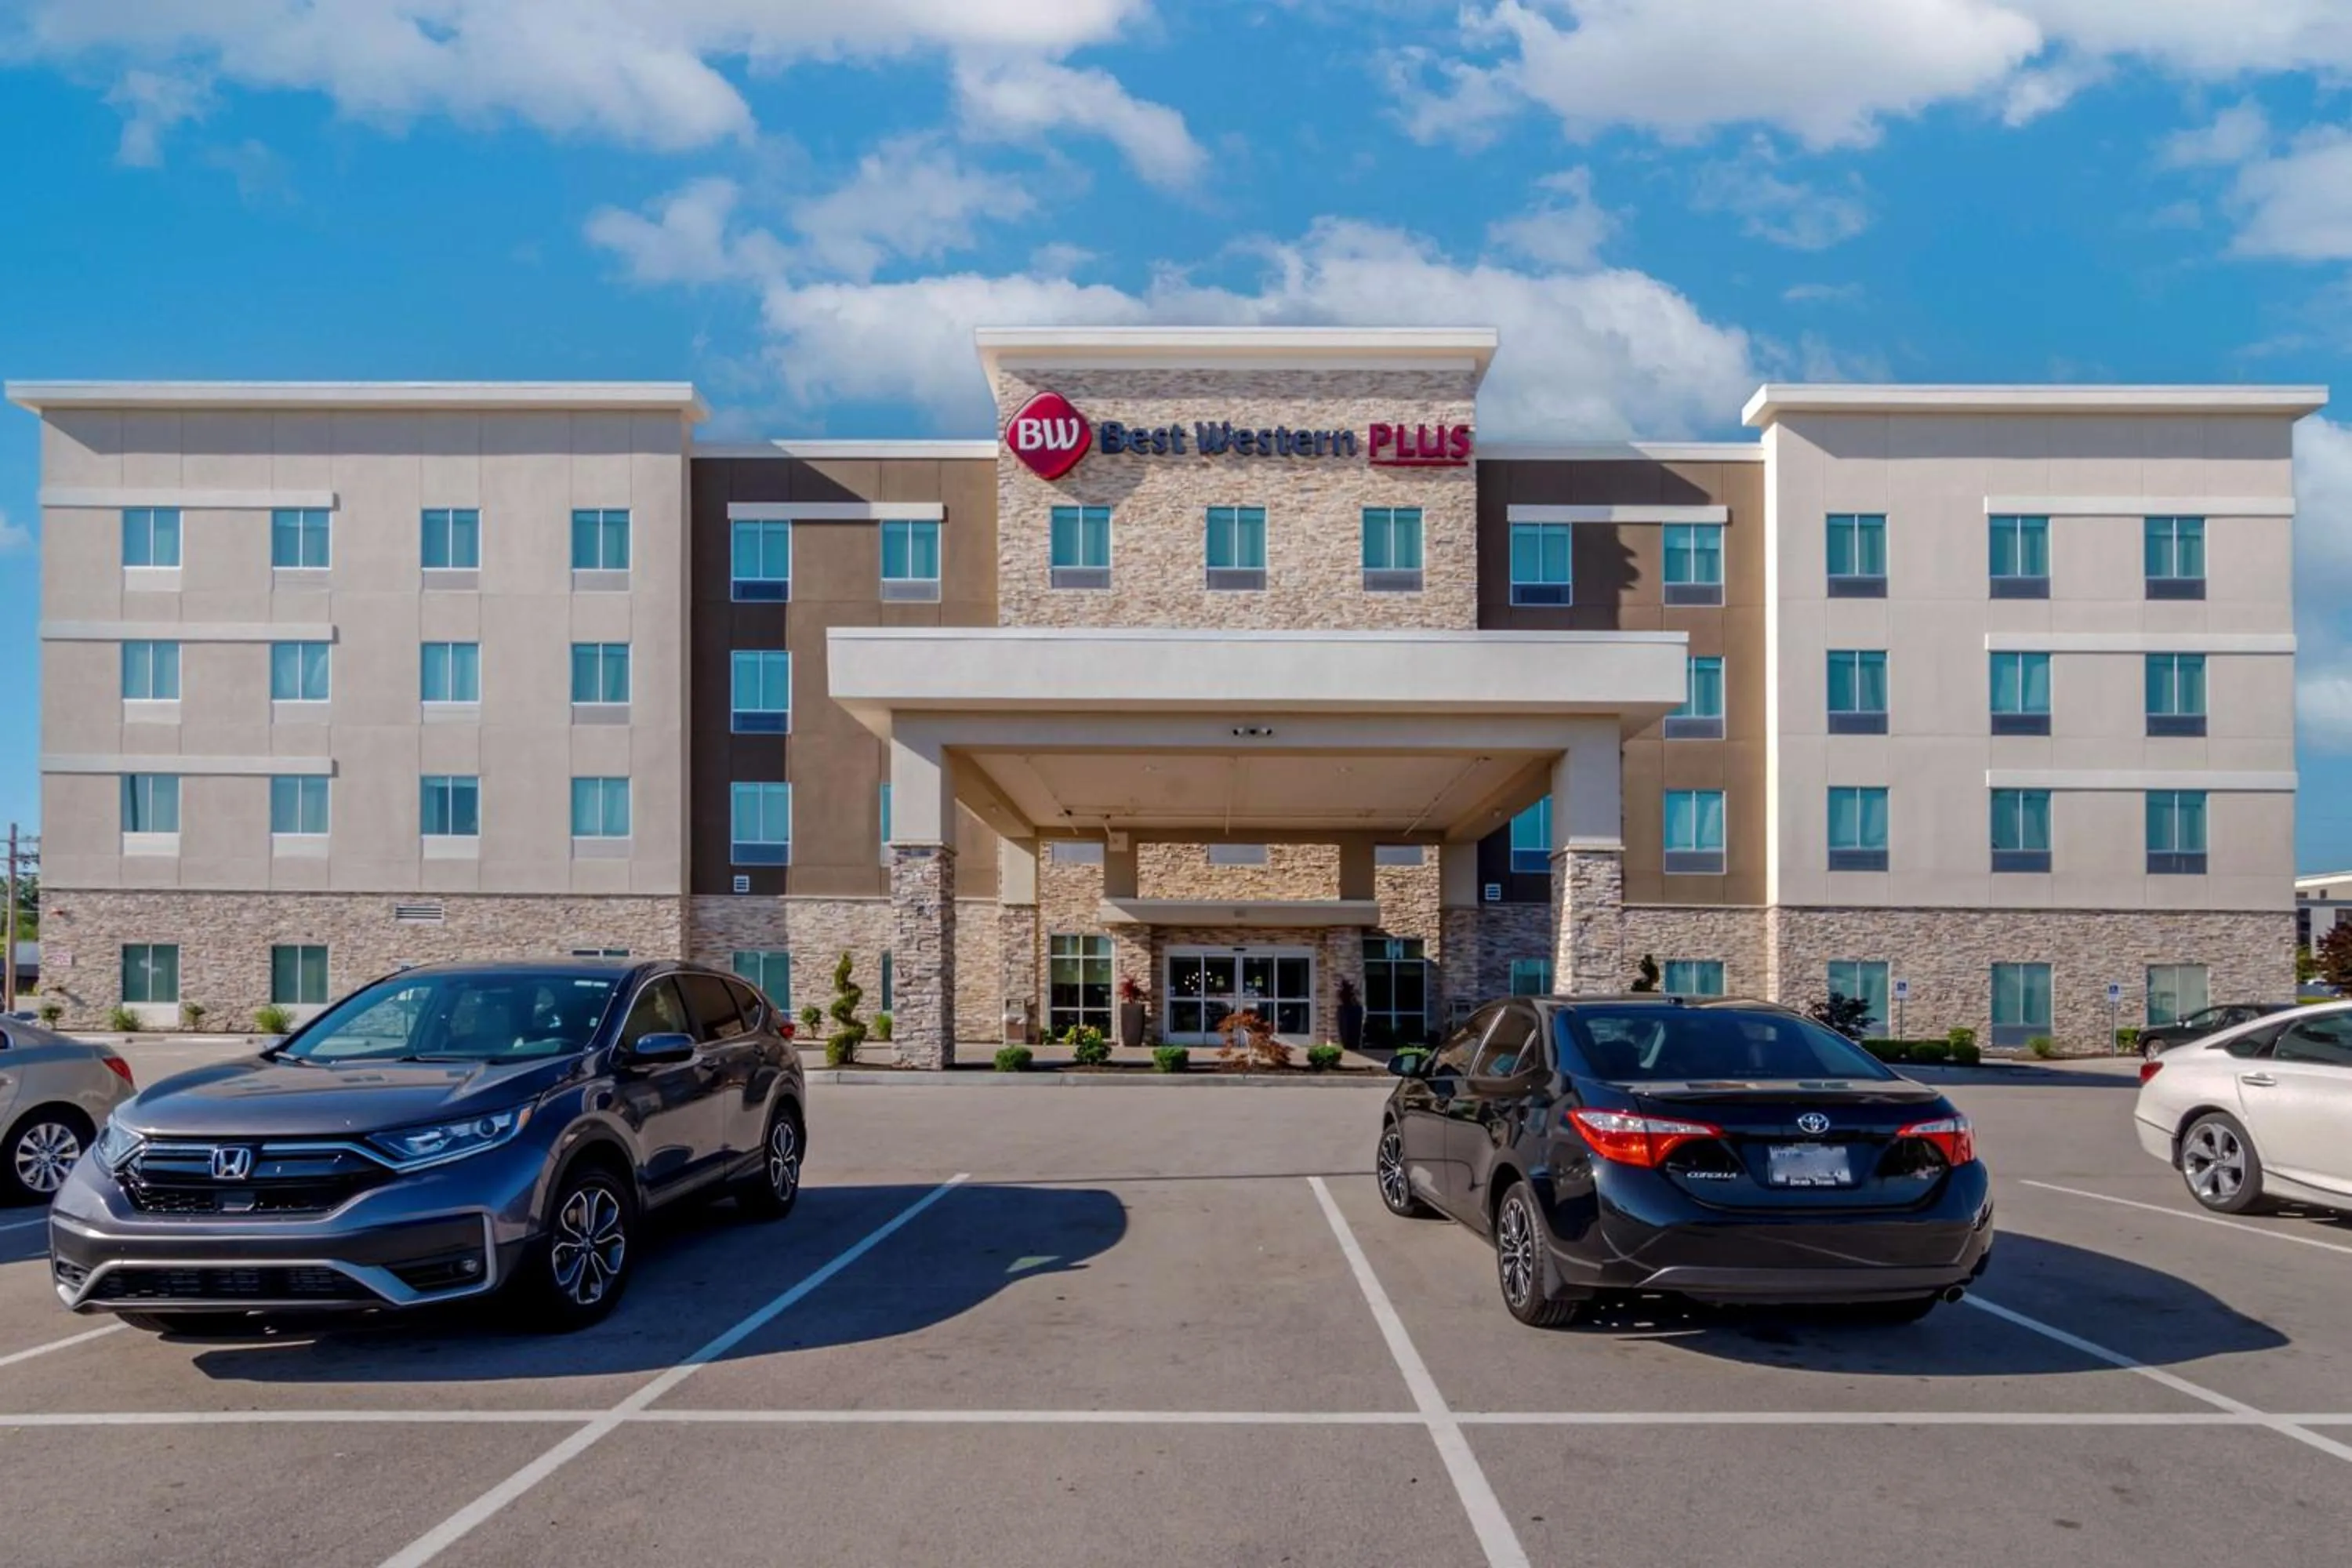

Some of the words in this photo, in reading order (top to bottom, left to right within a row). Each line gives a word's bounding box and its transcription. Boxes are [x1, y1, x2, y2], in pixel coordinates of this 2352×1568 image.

[1018, 417, 1080, 452] BW
[1100, 420, 1187, 456] Best
[1193, 419, 1358, 457] Western
